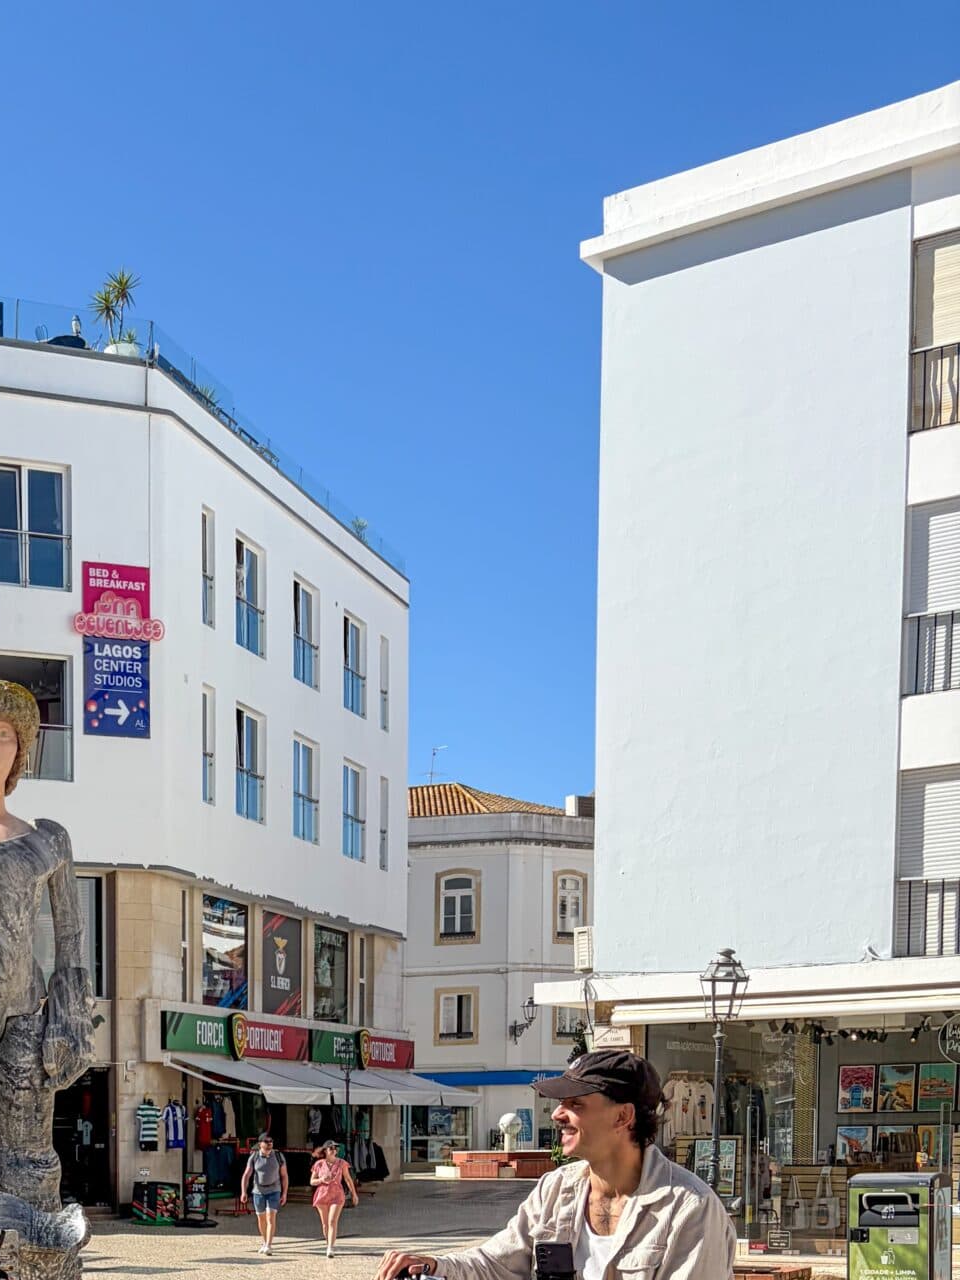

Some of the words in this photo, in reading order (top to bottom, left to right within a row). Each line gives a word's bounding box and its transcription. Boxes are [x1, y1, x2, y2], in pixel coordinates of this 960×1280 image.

[89, 567, 109, 578] BED
[111, 569, 120, 579] &
[89, 578, 146, 591] BREAKFAST
[94, 643, 142, 659] LAGOS
[94, 659, 142, 674] CENTER
[94, 674, 143, 688] STUDIOS
[196, 1020, 225, 1047] FORÇA
[371, 1041, 397, 1062] ORTUGAL
